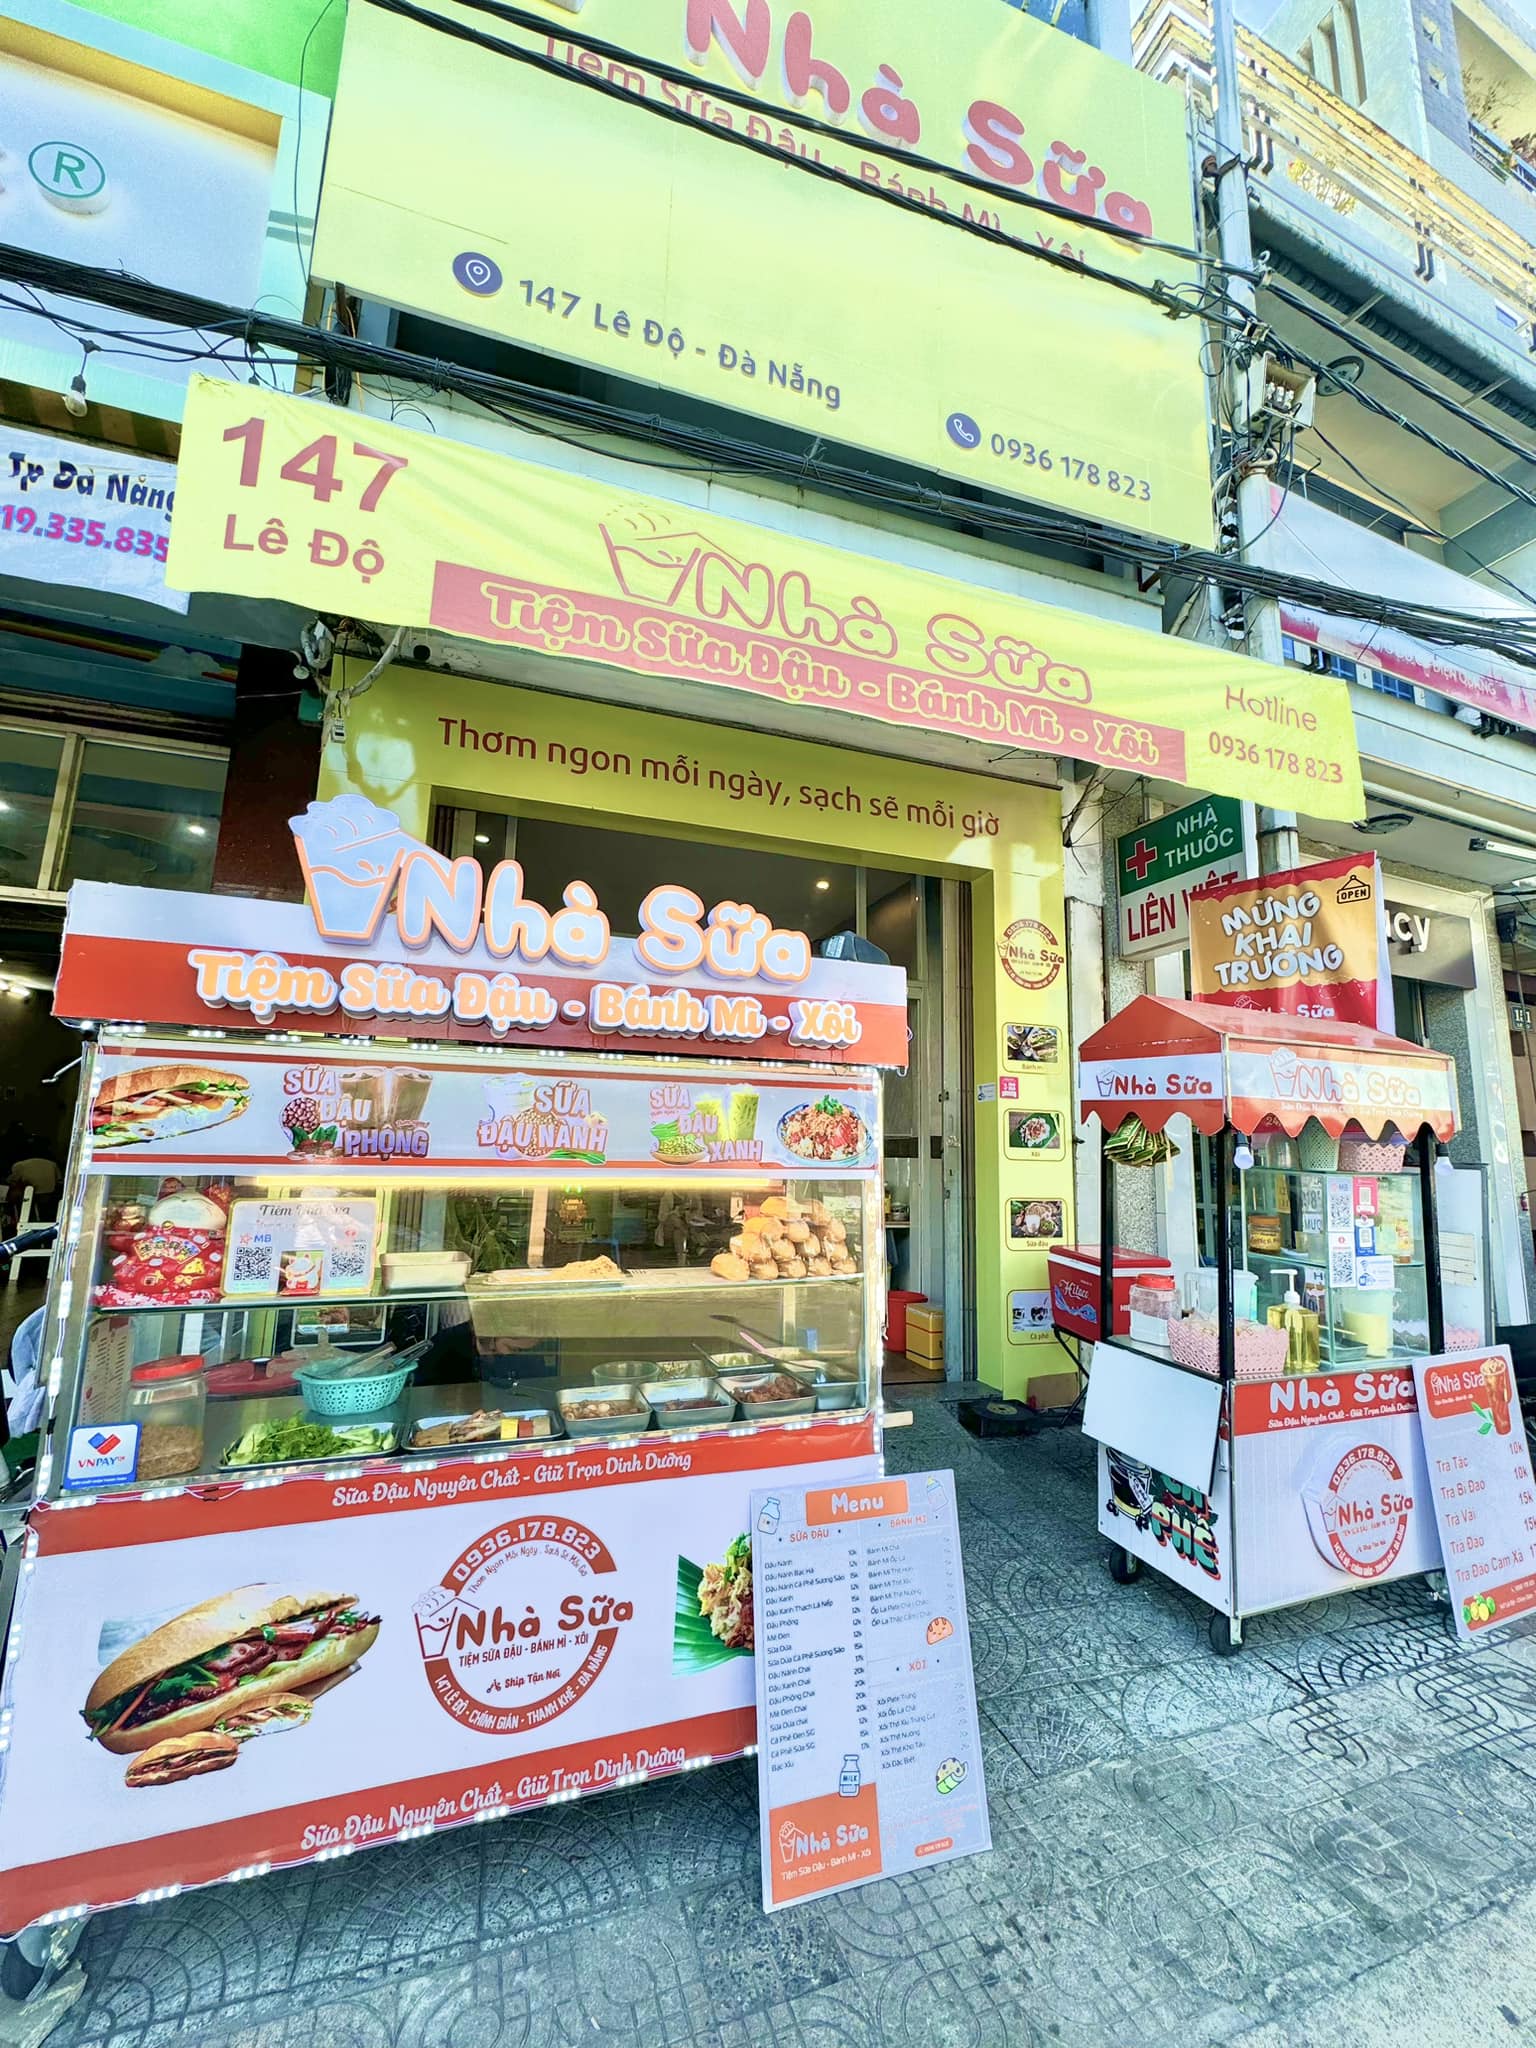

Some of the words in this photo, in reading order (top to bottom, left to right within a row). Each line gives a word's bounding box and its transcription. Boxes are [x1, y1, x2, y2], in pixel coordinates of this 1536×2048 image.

[966, 100, 1153, 240] Sữa
[520, 279, 581, 319] 147
[594, 303, 631, 336] Lê
[643, 319, 685, 359] Độ
[718, 343, 756, 378] Đà
[768, 360, 841, 411] Nẵng
[223, 417, 408, 513] 147
[990, 433, 1053, 471] 0936
[1060, 456, 1101, 486] 178
[1107, 470, 1151, 502] 823
[224, 514, 289, 556] Lê
[308, 528, 385, 585] Độ
[696, 552, 898, 660] Nhà
[926, 613, 1093, 704] Sữa
[481, 581, 630, 650] Tiệm
[633, 617, 743, 675] Sữa
[745, 641, 851, 700] Đậu
[887, 673, 1005, 732] Bánh
[1006, 700, 1064, 744] Mì
[1093, 718, 1160, 765] Xôi
[1225, 684, 1318, 732] Hotline
[437, 717, 537, 760] Thơm
[547, 742, 631, 776] ngon
[640, 754, 700, 786] mỗi
[708, 770, 792, 807] ngày,
[799, 783, 862, 815] sạch
[868, 791, 900, 820] sẽ
[906, 798, 956, 831] mỗi
[961, 810, 1001, 840] giờ
[1209, 731, 1260, 764] 0936
[1264, 747, 1300, 775] 178
[1305, 756, 1344, 784] 823
[1176, 804, 1218, 838] NHÀ
[1165, 825, 1234, 868] THUỐC
[1221, 891, 1320, 936] MỪNG
[1340, 888, 1368, 902] OPEN
[398, 851, 610, 966] Nhà
[637, 885, 811, 982] Sữa
[1127, 892, 1176, 942] LIÊN
[1235, 922, 1312, 956] KHAI
[1214, 944, 1344, 986] TRƯƠNG
[188, 949, 337, 1016] Tiệm
[340, 962, 450, 1016] Sữa
[453, 972, 555, 1031] Đậu
[591, 984, 708, 1036] Bánh
[705, 995, 766, 1039] Mì
[790, 1000, 861, 1046] Xôi
[284, 1064, 336, 1095] SỮA
[534, 1081, 591, 1118] SỮA
[1115, 1075, 1156, 1095] Nhà
[1167, 1074, 1212, 1095] Sữa
[1298, 1064, 1360, 1103] Nhà
[1368, 1072, 1421, 1106] Sữa
[477, 1116, 530, 1152] ĐẬU
[537, 1117, 608, 1152] NÀNH
[709, 1140, 763, 1163] XANH
[1270, 1378, 1341, 1414] Nhà
[1353, 1373, 1415, 1403] Sữa
[1438, 1374, 1461, 1394] Nhà
[1462, 1371, 1485, 1390] Sữa
[333, 1483, 369, 1506] Sữa
[372, 1480, 410, 1503] Đậu
[413, 1472, 478, 1500] Nguyên
[481, 1466, 520, 1490] Chất
[534, 1460, 564, 1483] Giữ
[566, 1459, 604, 1482] Trọn
[605, 1454, 643, 1477] Dinh
[645, 1452, 692, 1472] Dưỡng
[831, 1492, 885, 1516] Menu
[1338, 1499, 1374, 1527] Nhà
[1381, 1493, 1414, 1516] Sữa
[452, 1521, 601, 1583] 0936.178.823
[1491, 1556, 1511, 1571] Cam
[456, 1605, 541, 1650] Nhà
[558, 1595, 634, 1631] Sữa
[459, 1651, 480, 1668] TIỆM
[482, 1648, 500, 1663] SỮA
[503, 1643, 522, 1660] ĐẬU
[530, 1638, 555, 1654] BÁNH
[574, 1631, 589, 1646] XÔI
[504, 1676, 525, 1689] Ship
[526, 1700, 559, 1725] THANH
[300, 1824, 341, 1851] Sữa
[343, 1815, 385, 1844] Đậu
[388, 1798, 457, 1833] Nguyên
[460, 1783, 502, 1812] Chất
[517, 1775, 549, 1798] Giữ
[593, 1754, 634, 1782] Dinh
[635, 1746, 686, 1772] Dưỡng
[796, 1831, 831, 1858] Nhà
[836, 1823, 869, 1847] Sữa
